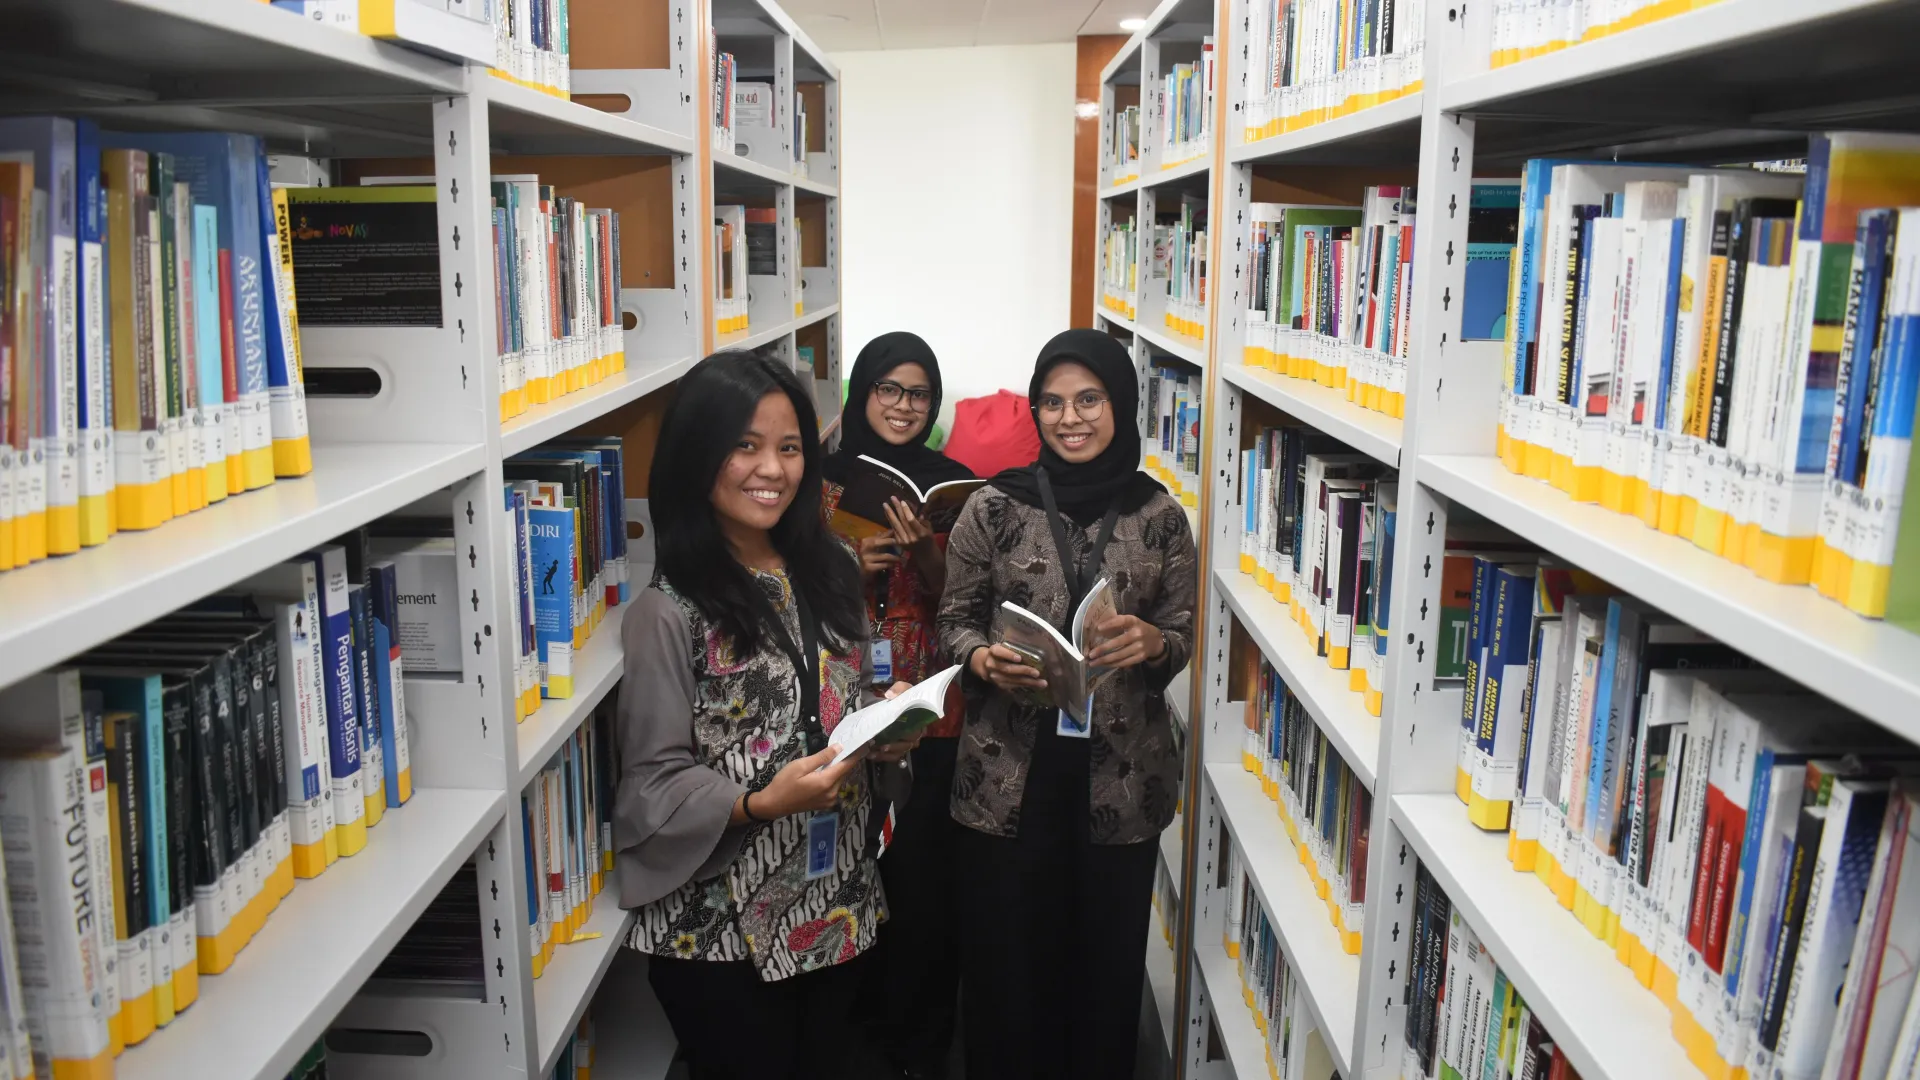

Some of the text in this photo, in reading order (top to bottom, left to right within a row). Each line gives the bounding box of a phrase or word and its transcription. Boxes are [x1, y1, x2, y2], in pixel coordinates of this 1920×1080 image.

[1273, 21, 1282, 84] SUCCESSION
[277, 203, 290, 265] POWER
[1521, 242, 1532, 288] METODE
[1566, 247, 1577, 275] THE
[62, 250, 76, 385] Pengantar Sistem
[89, 256, 102, 329] Pengantar
[1516, 291, 1528, 351] PENELITIAN
[1560, 279, 1576, 343] BALANCED
[1716, 259, 1737, 386] RESTRUKTURISASI
[92, 335, 102, 384] Sistem
[1671, 319, 1685, 398] MANAGERIAL
[1692, 262, 1718, 439] LOGISTICS SYSTEMS MANAGEMENT
[1836, 268, 1864, 407] MANAJEMEN
[1514, 353, 1525, 387] BISNIS
[1829, 414, 1844, 470] KEAR
[520, 524, 528, 553] SAP
[530, 524, 560, 538] DIRI
[308, 592, 321, 642] Service
[397, 593, 437, 605] ement
[310, 643, 326, 728] Management
[335, 634, 361, 764] Pengantar Bisnis
[360, 650, 374, 730] PEMASARAN
[1463, 659, 1474, 719] PENGANTAR
[1467, 662, 1478, 720] AKUNTANSI
[1526, 658, 1535, 684] STUDI
[217, 700, 229, 719] 4
[253, 674, 268, 760] 6 Kinerja
[266, 664, 285, 784] 7 Produktivitas
[296, 658, 310, 757] Resource Management
[304, 693, 313, 724] Human
[1479, 676, 1493, 740] PENGANTAR
[1485, 678, 1499, 741] AKUNTANSI
[1522, 685, 1533, 731] KELAYAKAN
[1551, 684, 1568, 774] AKUNTANSI
[1562, 665, 1580, 776] ACCOUNTING
[152, 724, 161, 758] SUPPLY
[237, 688, 254, 795] 5 Kreativitas
[1601, 703, 1618, 789] AKUNTANSI
[1621, 736, 1635, 806] Payroll Accounting
[65, 772, 77, 804] THE
[156, 833, 167, 893] MANAGEMENT
[1630, 809, 1643, 855] SEKTOR
[63, 804, 95, 936] FUTURE
[1692, 825, 1715, 928] Sistem Akuntansi
[1707, 839, 1731, 947] Sistem Akuntansi
[1798, 857, 1828, 951] INTERNAL
[1410, 914, 1424, 980] AKUNTANSI
[1422, 927, 1435, 993] AKUNTANSI
[1428, 932, 1442, 1000] AKUNTANSI
[1443, 964, 1457, 1060] Akuntansi Keuangan
[1471, 988, 1482, 1037] Akuntansi
[1783, 959, 1807, 1019] AUDIT
[1458, 973, 1474, 1070] Akuntansi Keuangan
[1481, 998, 1492, 1048] Akuntansi
[1486, 1006, 1503, 1065] AKUNTANSI
[1521, 1045, 1537, 1080] AKUN
